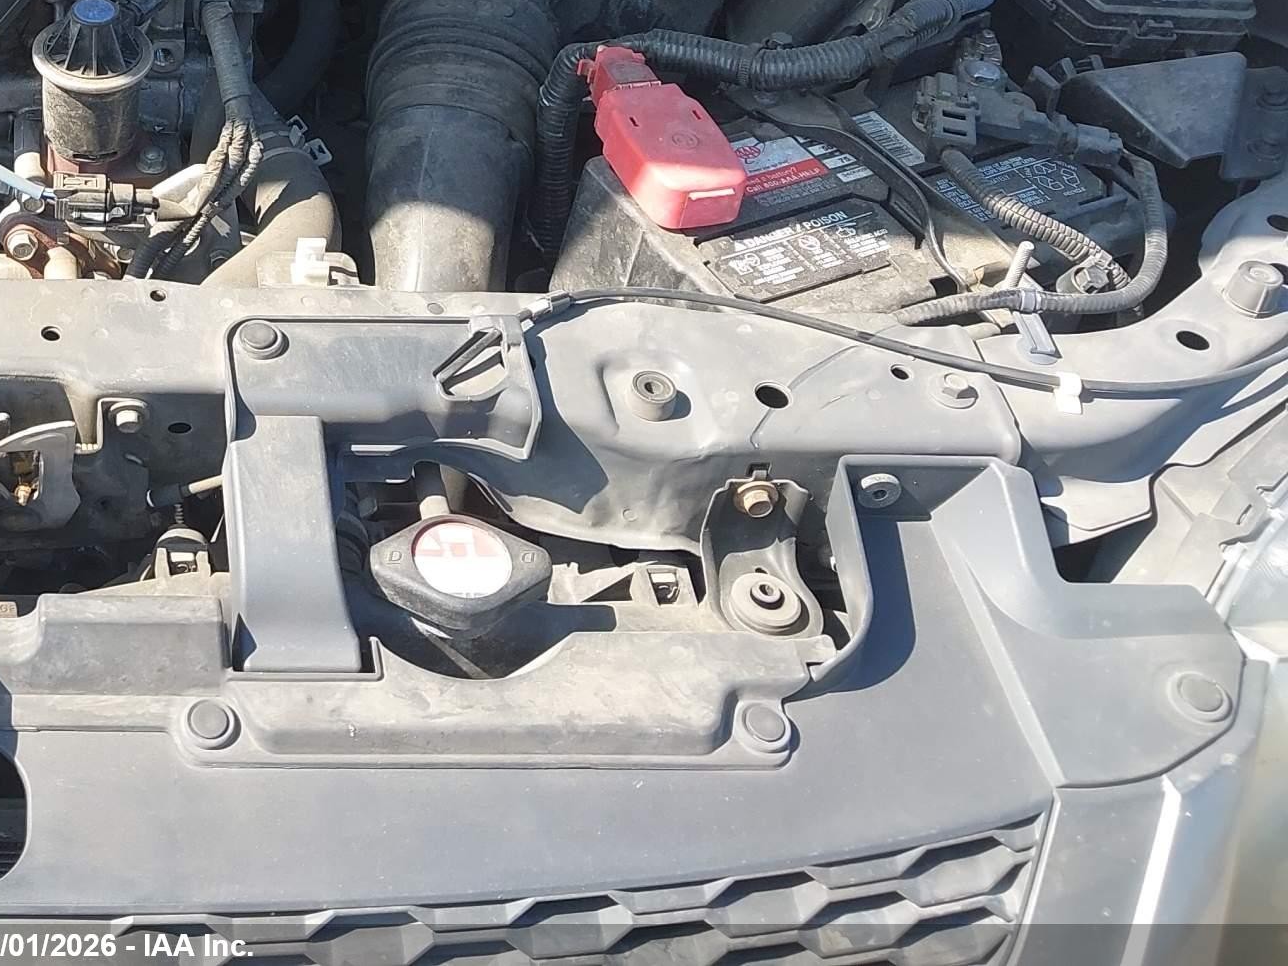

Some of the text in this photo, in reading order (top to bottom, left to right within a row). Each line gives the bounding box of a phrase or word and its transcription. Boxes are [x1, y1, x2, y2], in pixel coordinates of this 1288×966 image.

[746, 185, 762, 194] Call
[747, 227, 795, 247] DANGER
[803, 211, 848, 229] POISON
